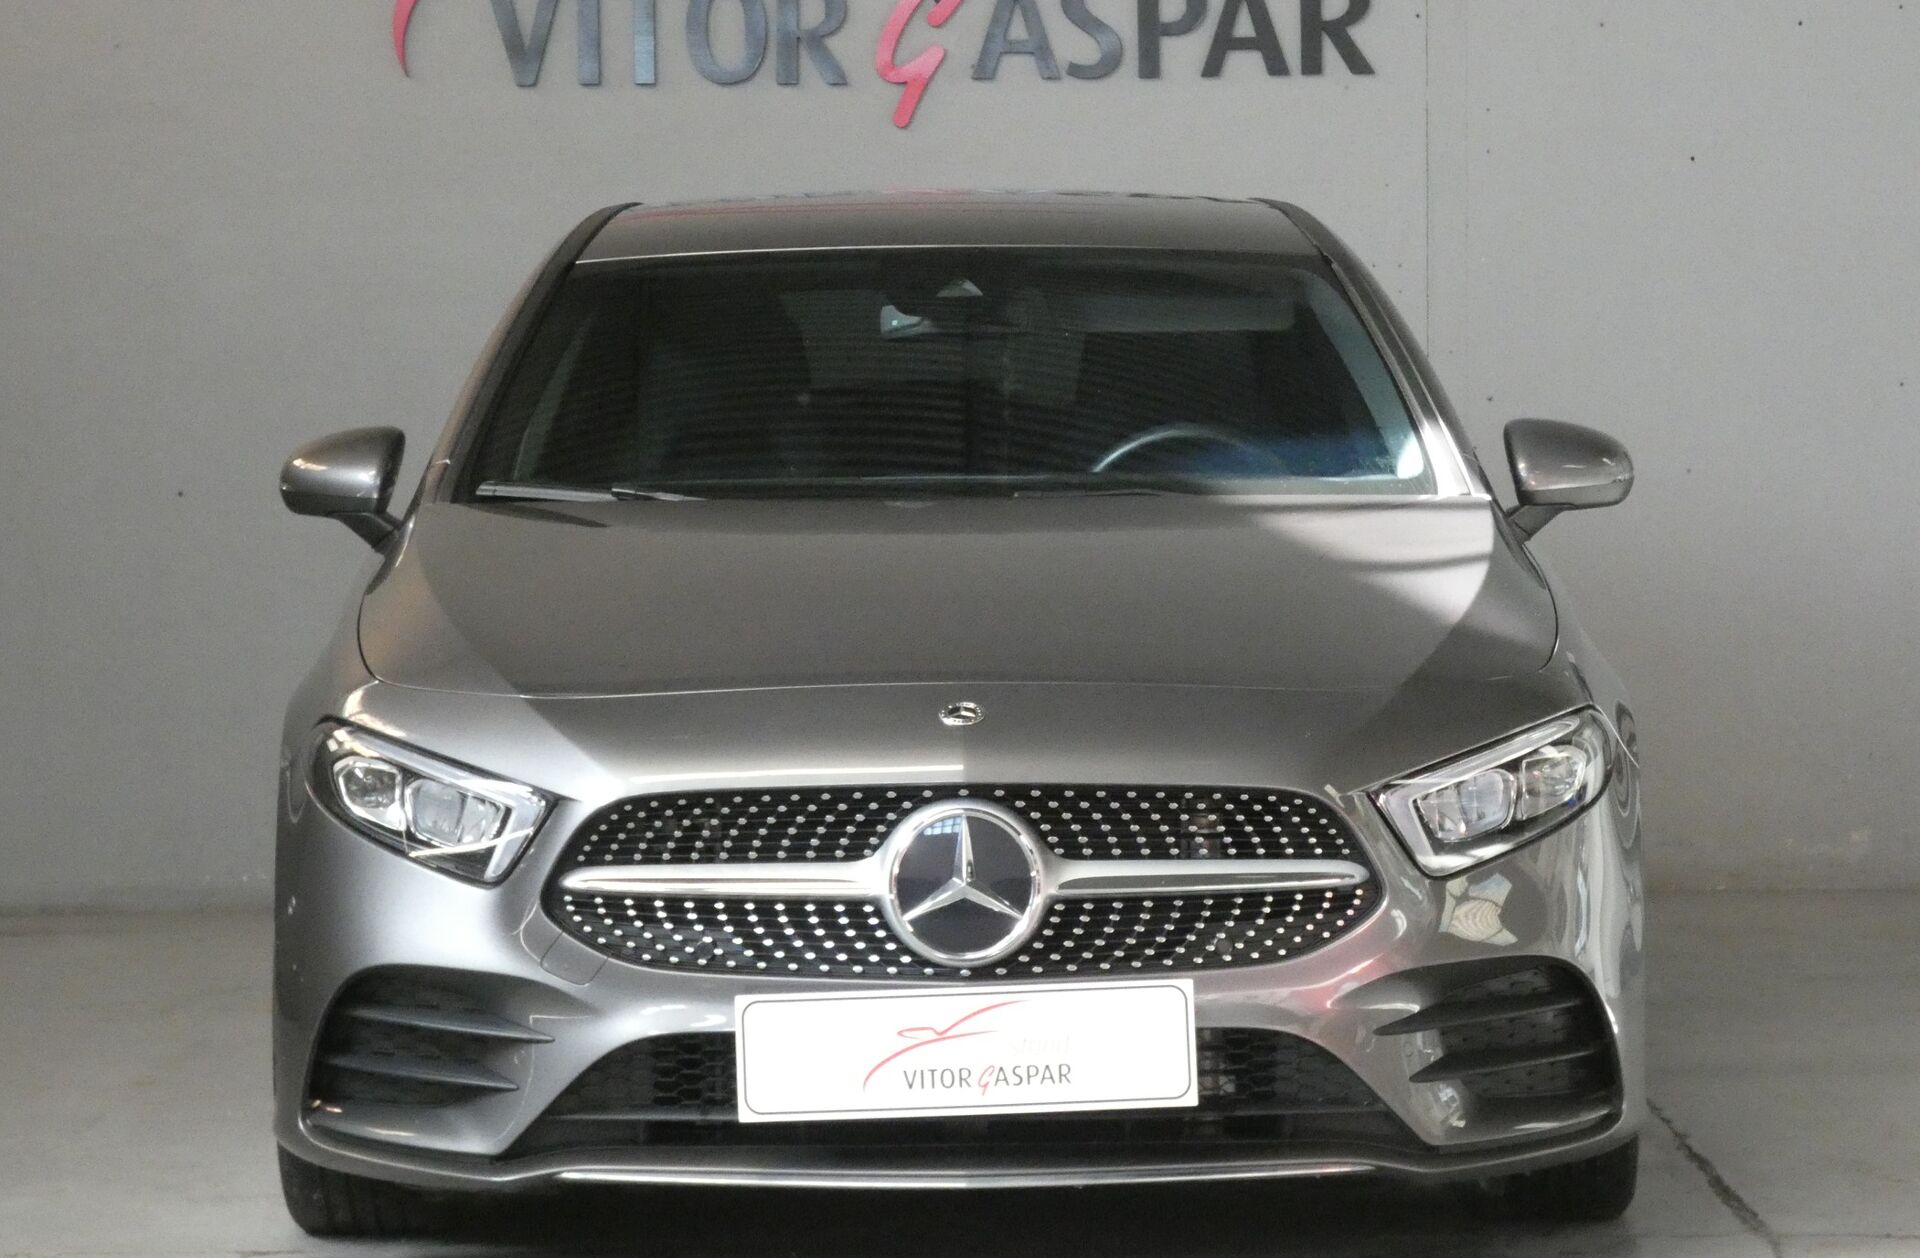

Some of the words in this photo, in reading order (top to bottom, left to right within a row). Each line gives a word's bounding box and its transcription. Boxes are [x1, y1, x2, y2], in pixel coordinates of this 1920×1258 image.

[876, 0, 1375, 128] GASPAR
[903, 1067, 972, 1090] VITOR
[978, 1064, 1072, 1096] GASPAR
